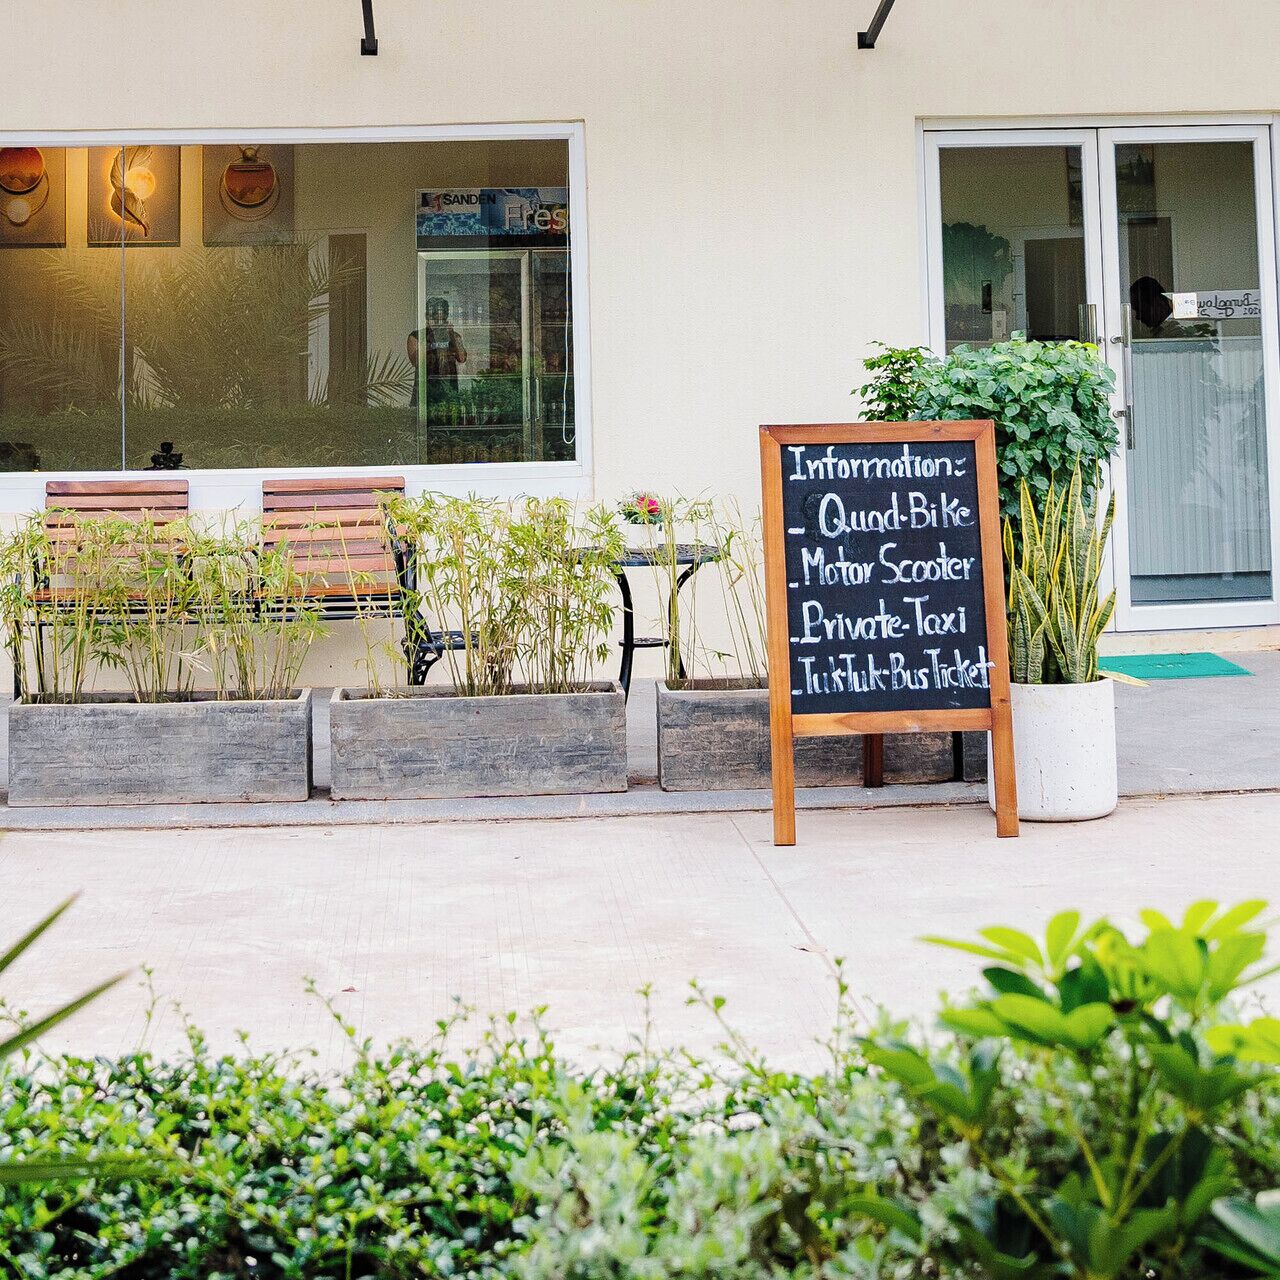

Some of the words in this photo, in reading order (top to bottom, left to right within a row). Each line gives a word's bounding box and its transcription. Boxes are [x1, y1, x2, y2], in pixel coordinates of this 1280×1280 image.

[443, 193, 496, 206] SANDEN
[787, 443, 967, 482] Information:
[801, 545, 875, 587] Motor
[879, 542, 975, 585] Scooter
[923, 645, 996, 690] Ticket
